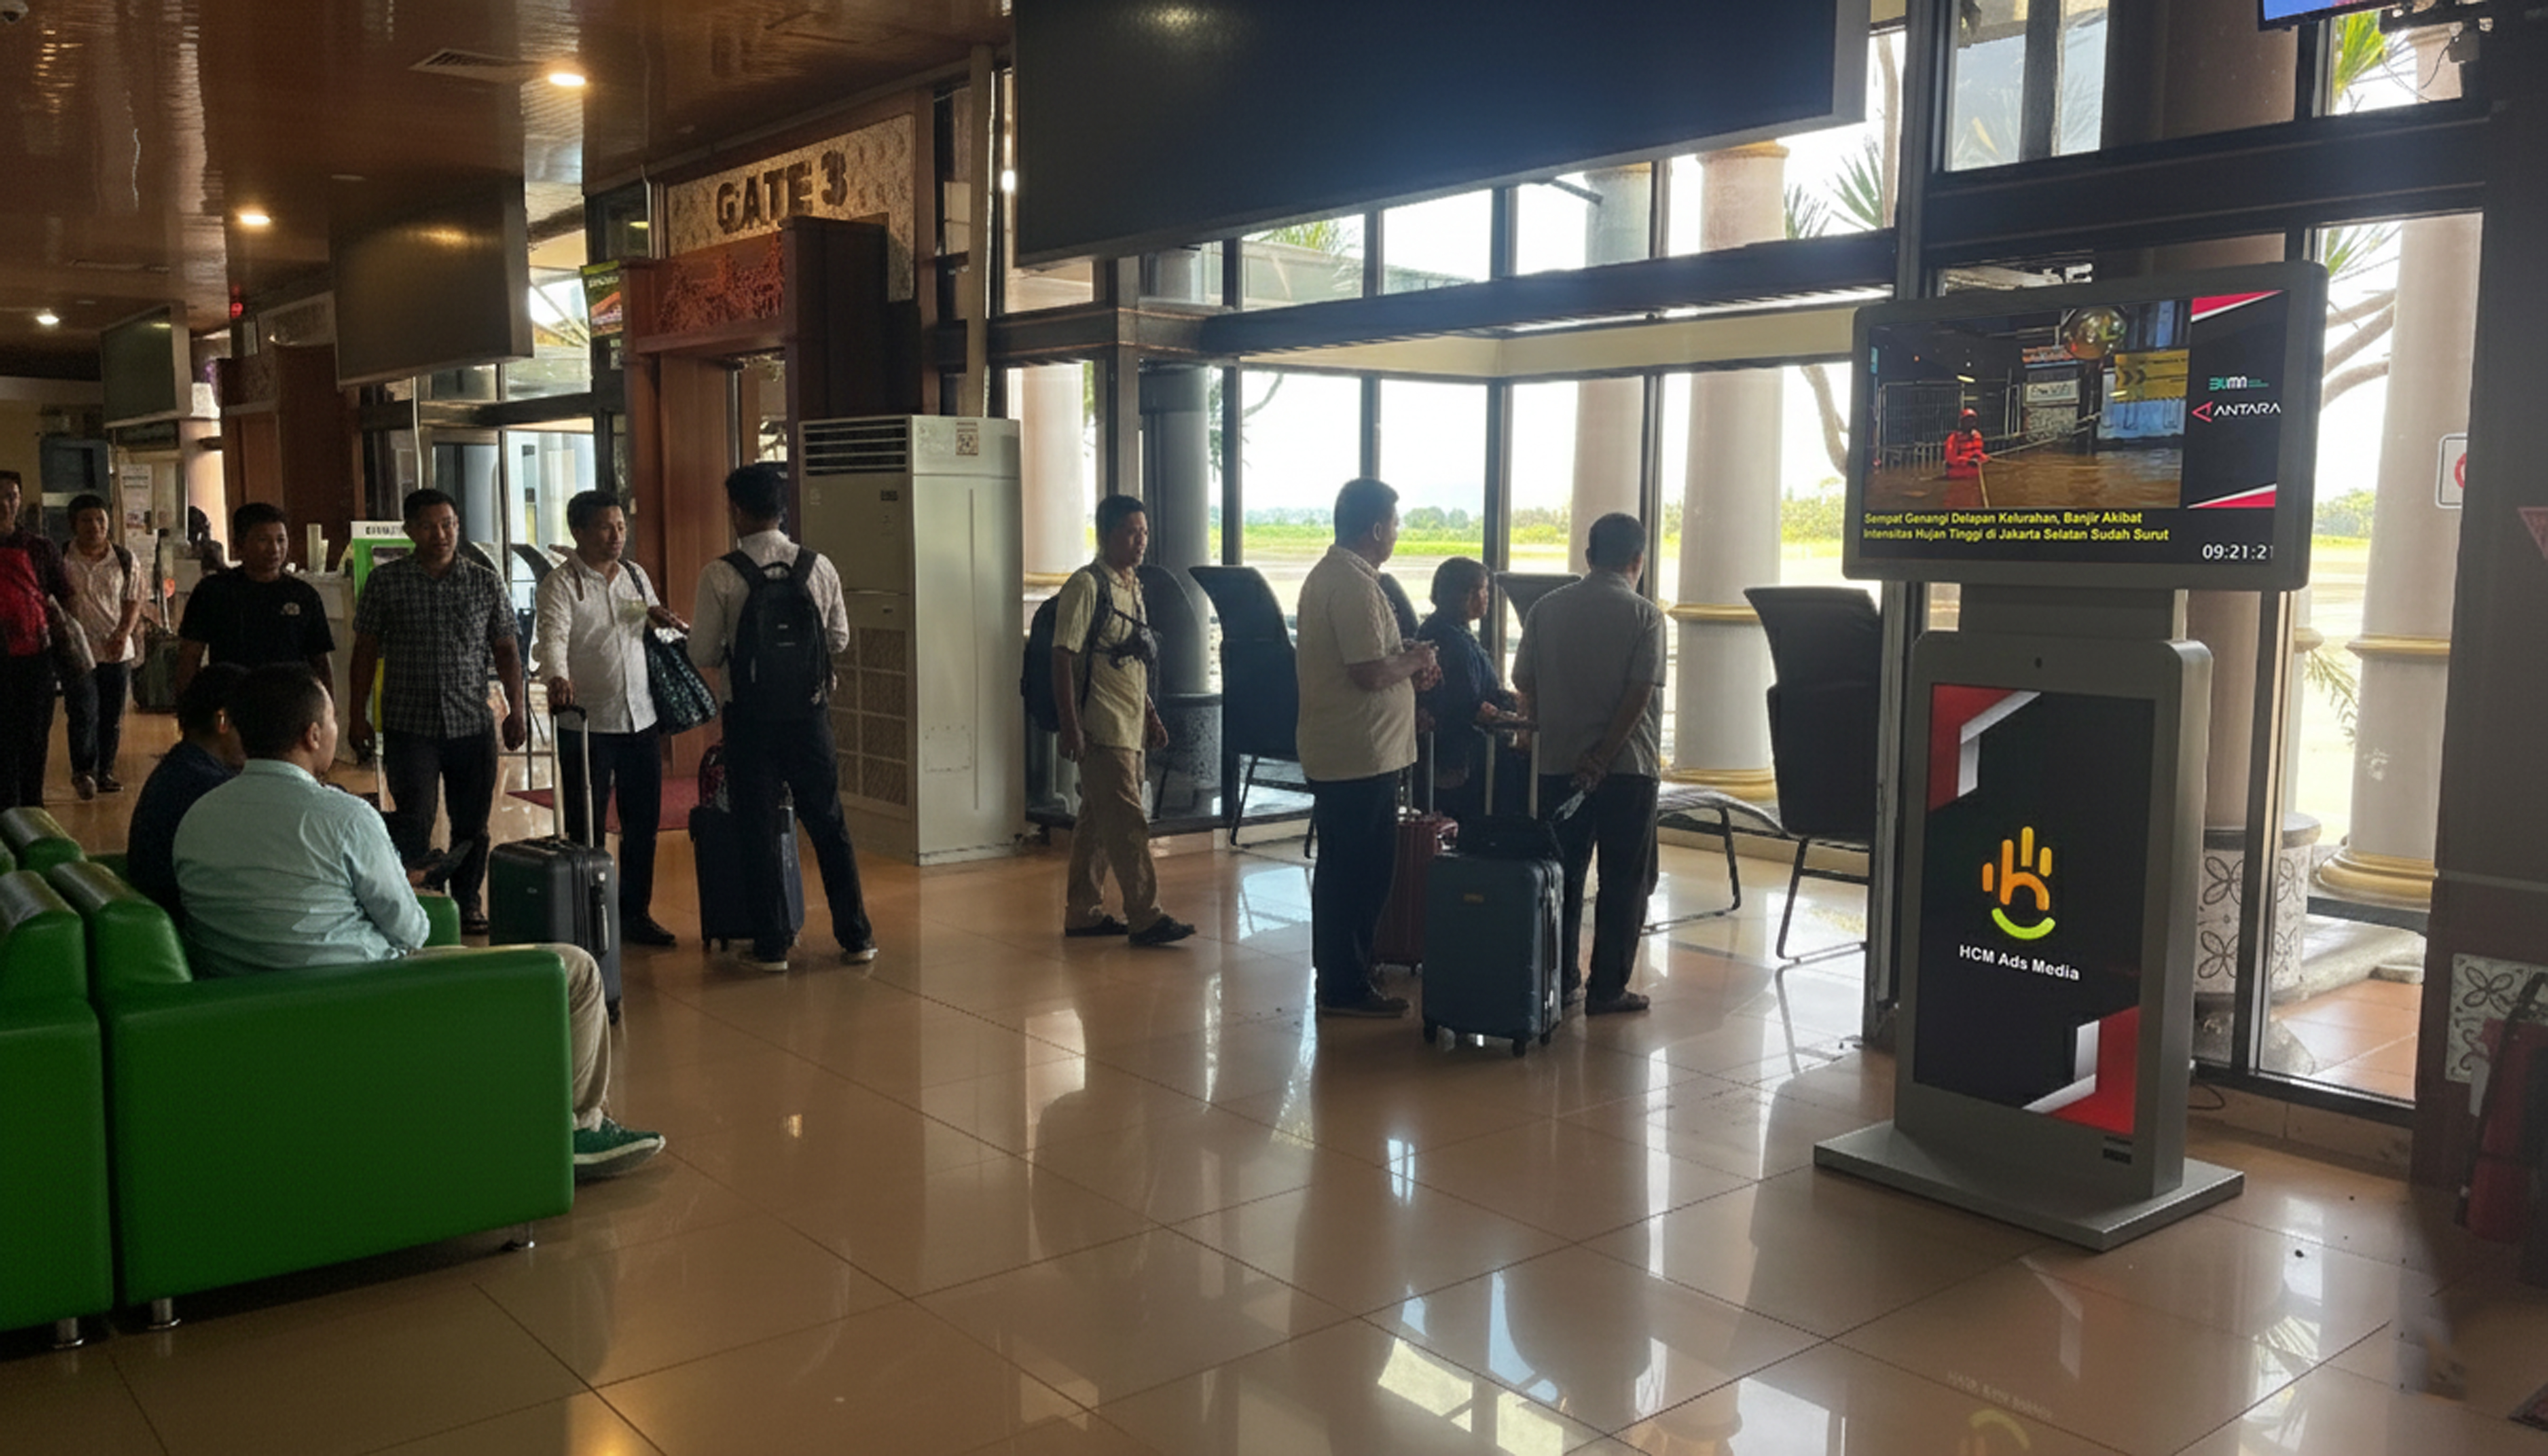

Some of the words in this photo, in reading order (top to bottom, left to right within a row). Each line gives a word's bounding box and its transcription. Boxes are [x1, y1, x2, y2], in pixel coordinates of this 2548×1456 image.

[717, 161, 814, 235] GATE
[821, 149, 848, 207] 3
[2214, 402, 2281, 416] ANTARA
[1864, 513, 1902, 526] Sempat
[1905, 512, 1949, 526] Genangi
[1951, 513, 1996, 526] Delapan
[1998, 512, 2060, 525] Kelurahan,
[2063, 512, 2099, 526] Banjir
[2102, 512, 2142, 523] Akibat
[1864, 528, 1913, 539] Intensitas
[1916, 528, 1946, 541] Hujan
[1949, 528, 1983, 542] Tinggi
[1985, 528, 1997, 539] di
[1999, 528, 2040, 540] Jakarta
[2043, 528, 2088, 540] Selatan
[2091, 528, 2130, 541] Sudah
[2133, 528, 2169, 541] Surut
[1959, 944, 1995, 963] HCM
[1997, 953, 2027, 970] Ads
[2032, 959, 2080, 980] Media
